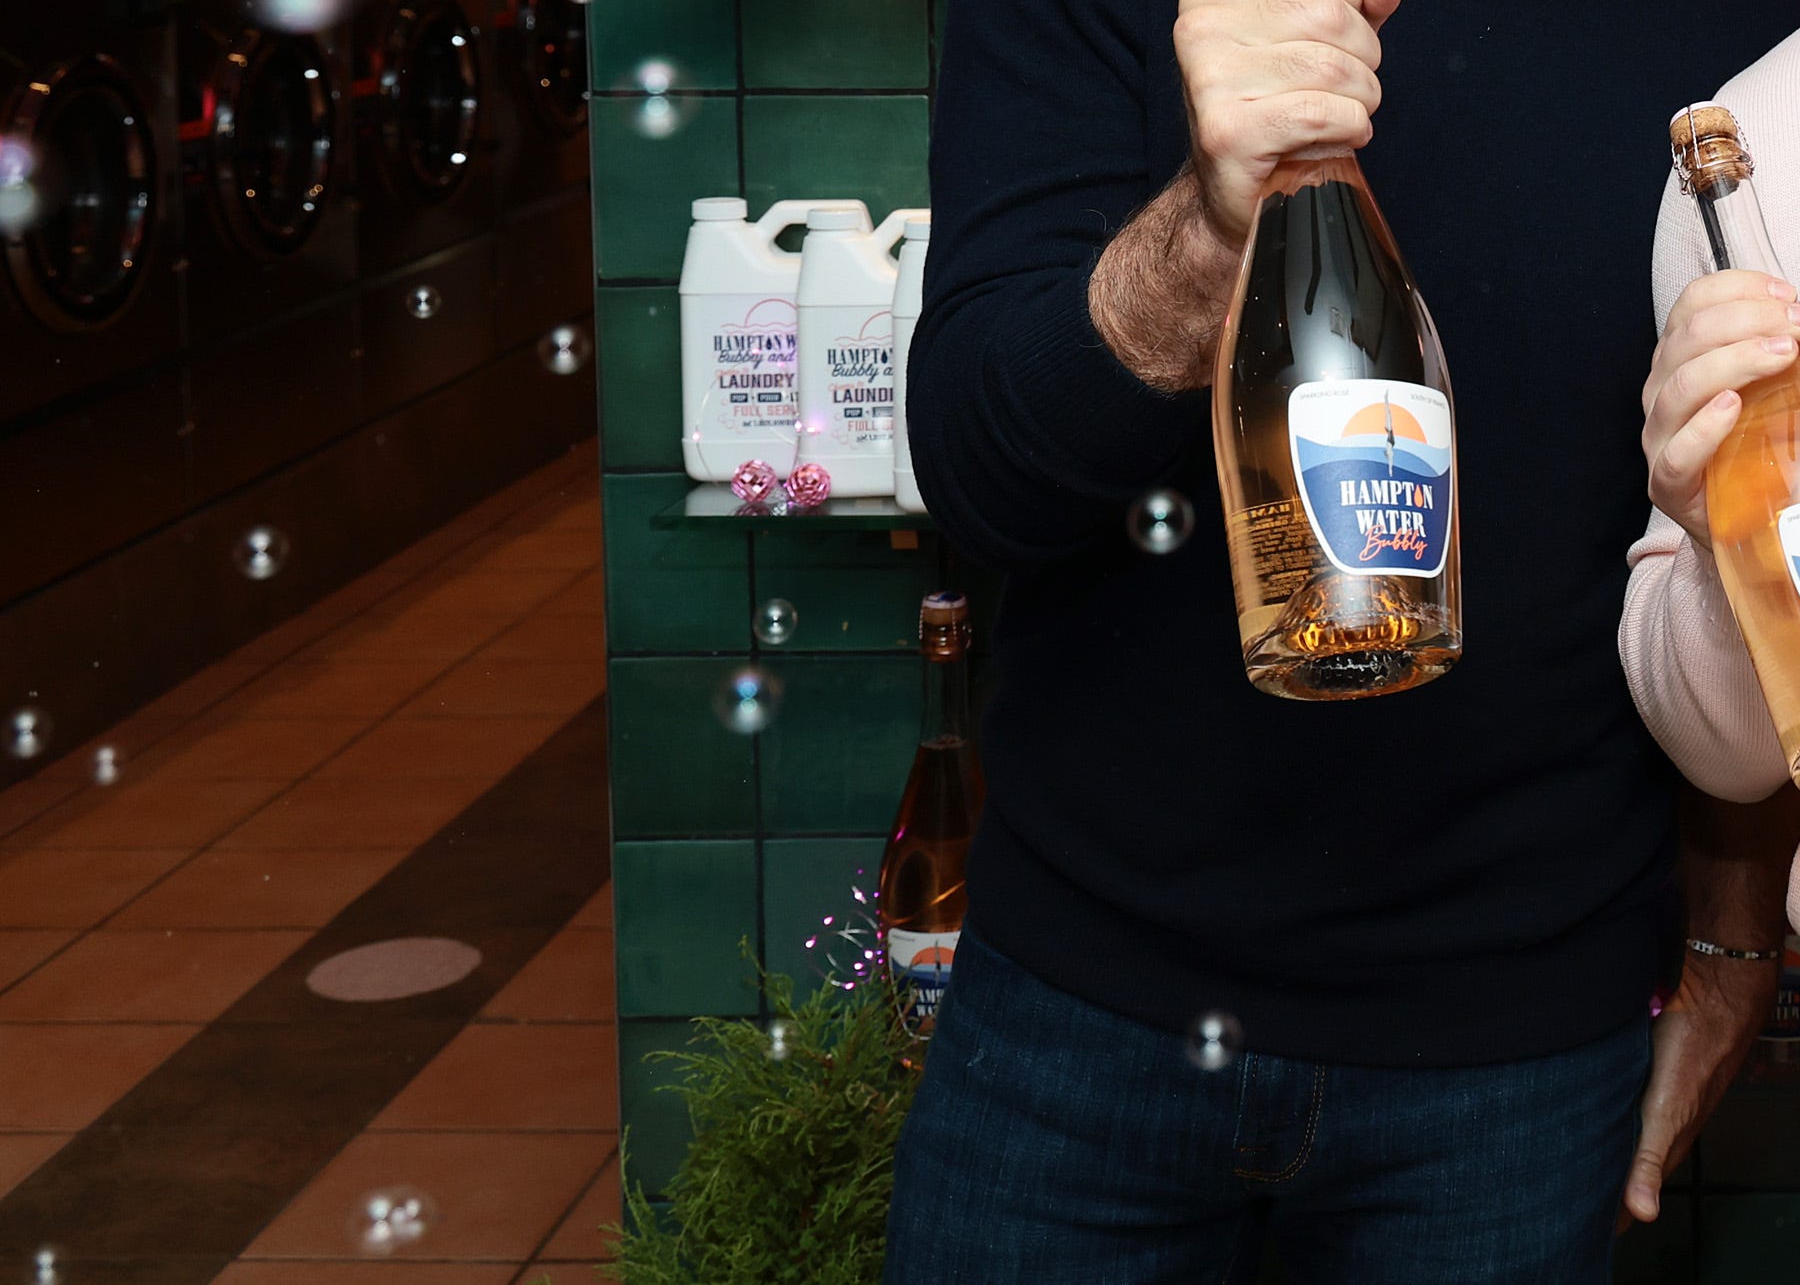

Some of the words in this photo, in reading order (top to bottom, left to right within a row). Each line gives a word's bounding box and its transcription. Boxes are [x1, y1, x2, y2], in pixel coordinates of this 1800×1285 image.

[714, 334, 782, 351] HAMPTON
[719, 373, 795, 389] LAUNDRY
[831, 363, 879, 383] Bubbly
[833, 387, 893, 403] LAUND
[1340, 479, 1434, 510] HAMPTON
[1355, 509, 1427, 537] WATER
[1358, 524, 1428, 561] Bubbly
